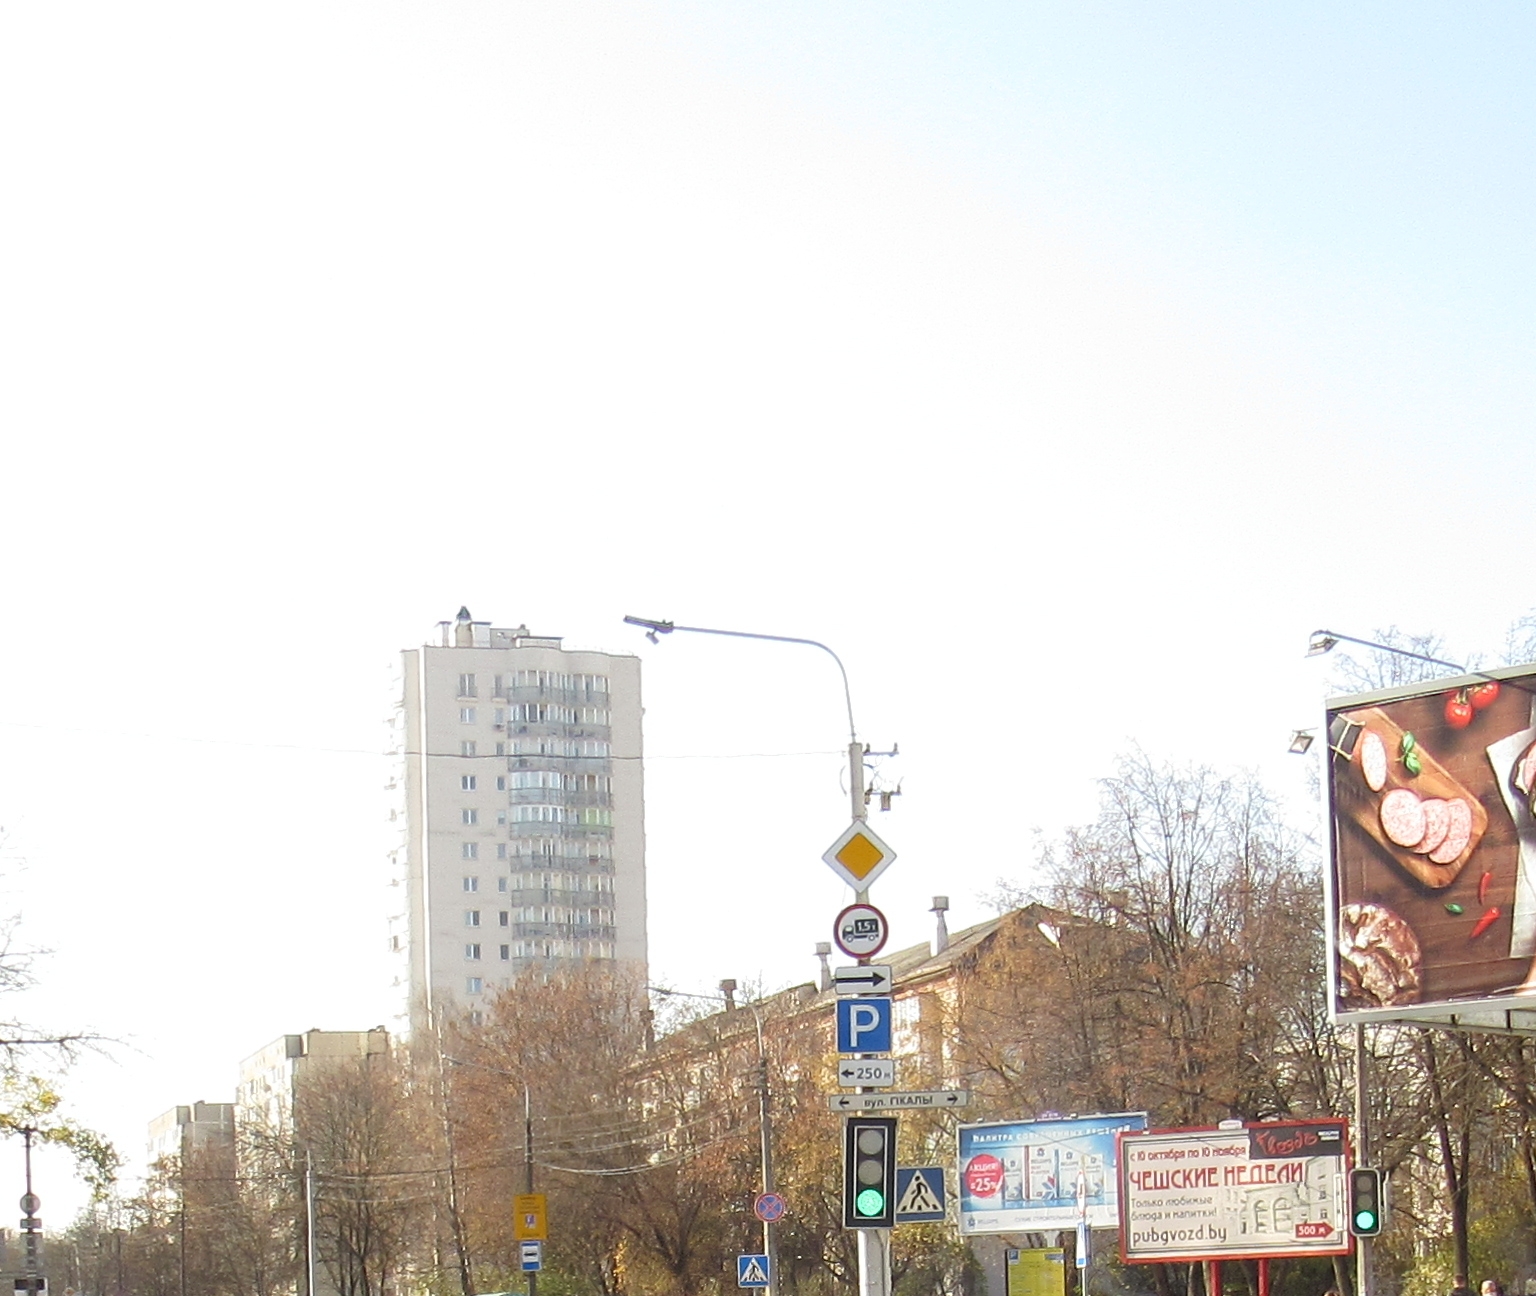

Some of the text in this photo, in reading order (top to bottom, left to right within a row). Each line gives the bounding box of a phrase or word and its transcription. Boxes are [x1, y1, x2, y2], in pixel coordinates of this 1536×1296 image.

[856, 1067, 883, 1080] 250
[864, 1099, 886, 1109] вул.
[1137, 1151, 1146, 1161] 10
[1148, 1148, 1186, 1162] октября
[1187, 1149, 1199, 1158] по
[1201, 1147, 1210, 1157] 10
[1213, 1146, 1246, 1160] ноября
[1129, 1162, 1304, 1191] ЧЕШСКИЕ НЕДЕЛИ
[1131, 1195, 1213, 1208] Только любимые
[1131, 1208, 1163, 1222] блюда
[1172, 1207, 1217, 1219] напитки!
[1132, 1223, 1228, 1247] pubgvozd.by
[1298, 1225, 1316, 1236] 500
